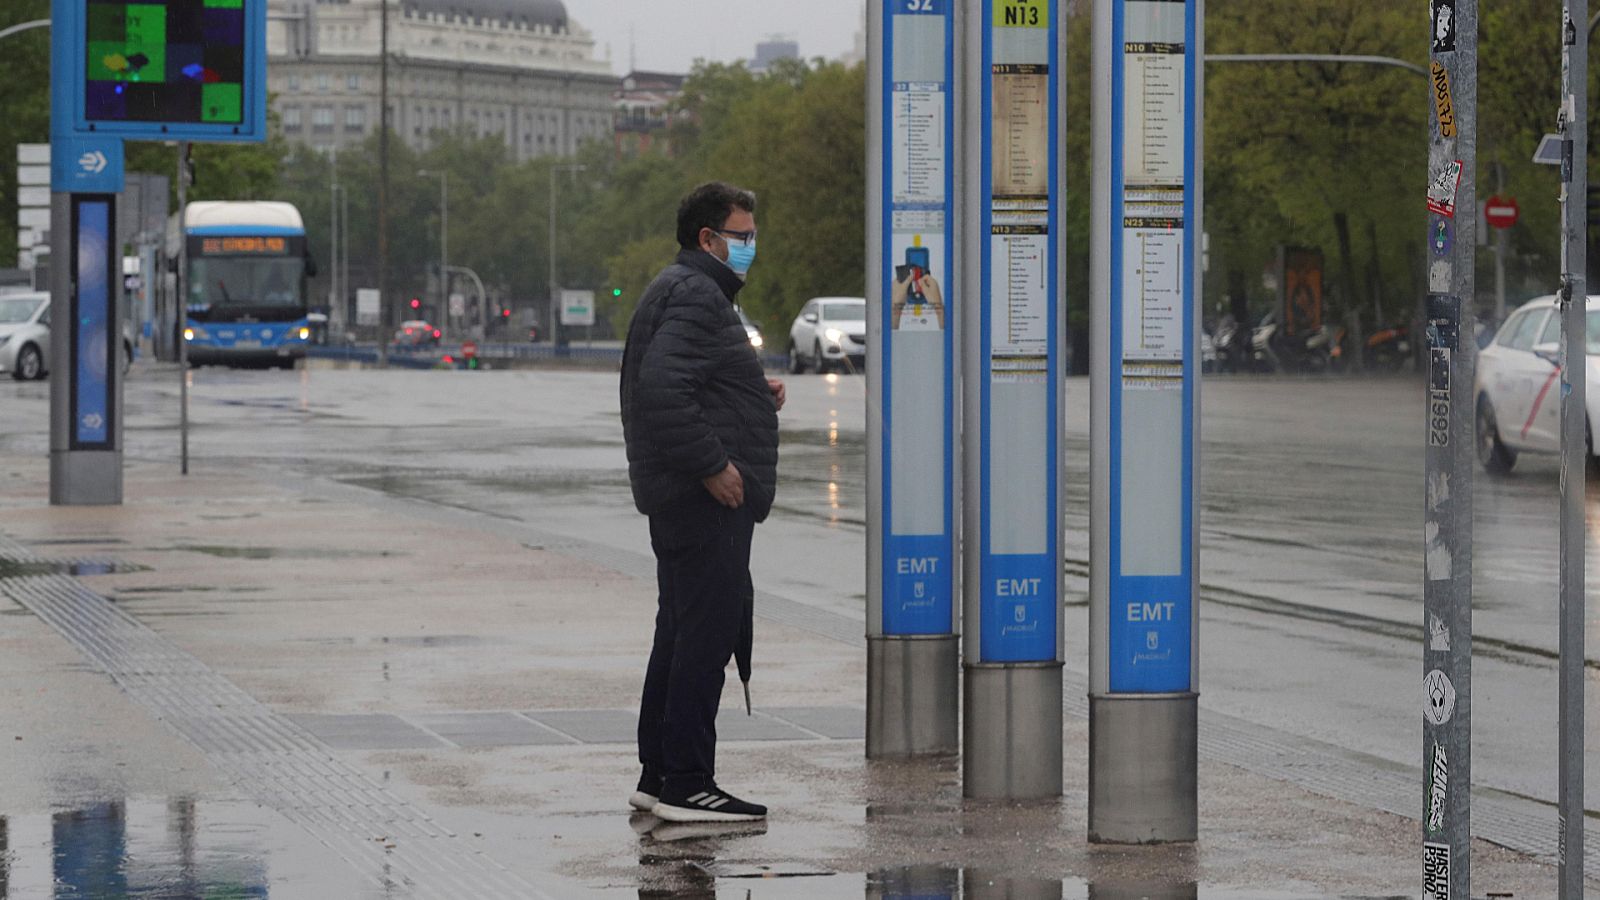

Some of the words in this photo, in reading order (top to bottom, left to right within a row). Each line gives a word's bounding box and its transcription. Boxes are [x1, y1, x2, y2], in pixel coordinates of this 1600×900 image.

[1005, 6, 1038, 25] N13
[1125, 44, 1145, 52] N10
[992, 65, 1010, 73] N11
[1124, 218, 1144, 227] N25
[897, 558, 938, 574] EMT
[996, 578, 1041, 596] EMT
[1127, 602, 1175, 621] EMT
[1436, 847, 1449, 900] HASTER
